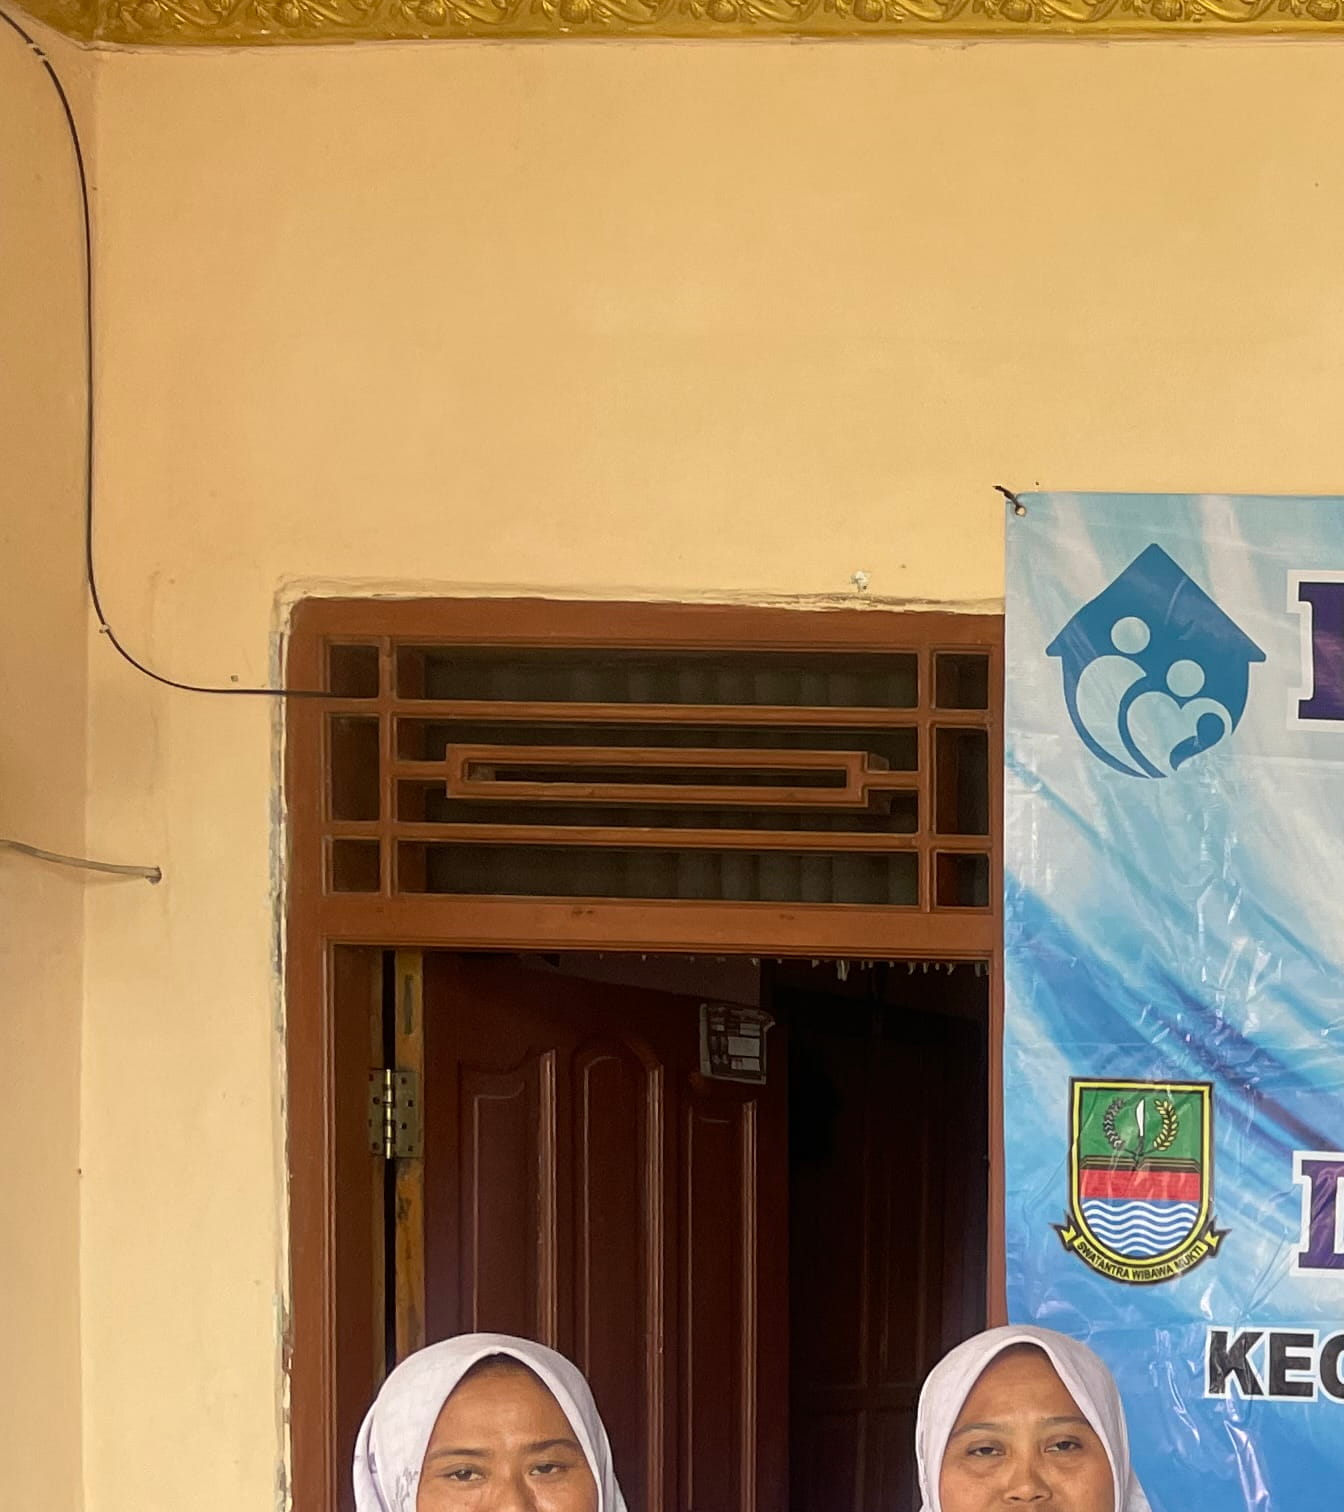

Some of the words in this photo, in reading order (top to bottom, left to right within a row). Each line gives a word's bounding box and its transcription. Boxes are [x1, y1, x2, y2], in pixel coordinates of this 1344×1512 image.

[1076, 1241, 1131, 1280] SWATANTRA
[1131, 1264, 1175, 1281] WIBAWA
[1173, 1244, 1205, 1272] MUKTI
